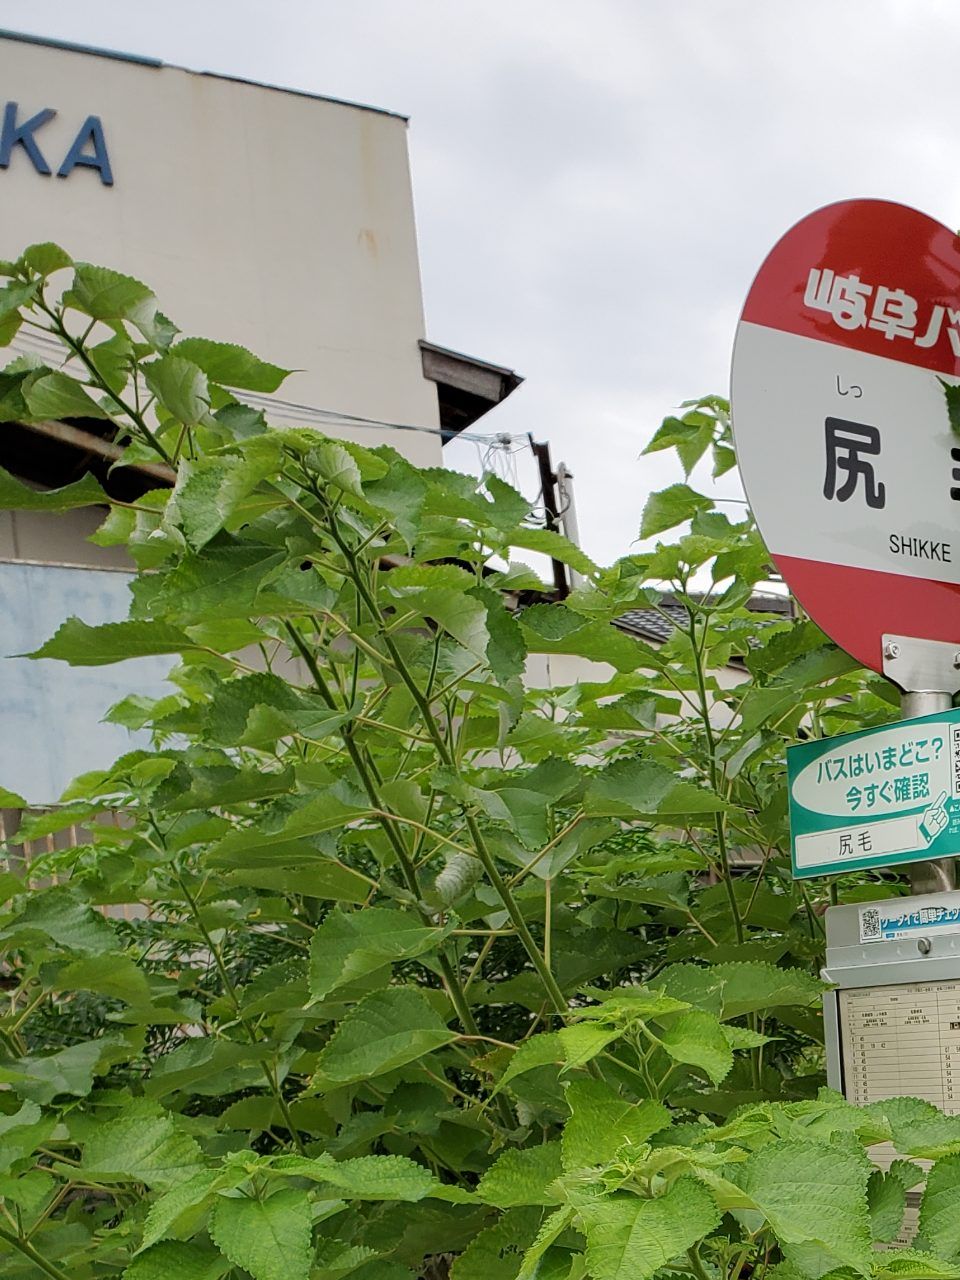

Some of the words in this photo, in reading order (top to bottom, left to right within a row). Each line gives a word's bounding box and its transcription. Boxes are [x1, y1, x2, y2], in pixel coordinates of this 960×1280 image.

[0, 101, 114, 186] KA
[889, 534, 952, 563] SHIKKE
[817, 737, 943, 784] バスはいまどこ？
[846, 773, 930, 811] 今すぐ確認
[839, 831, 872, 856] 尻毛
